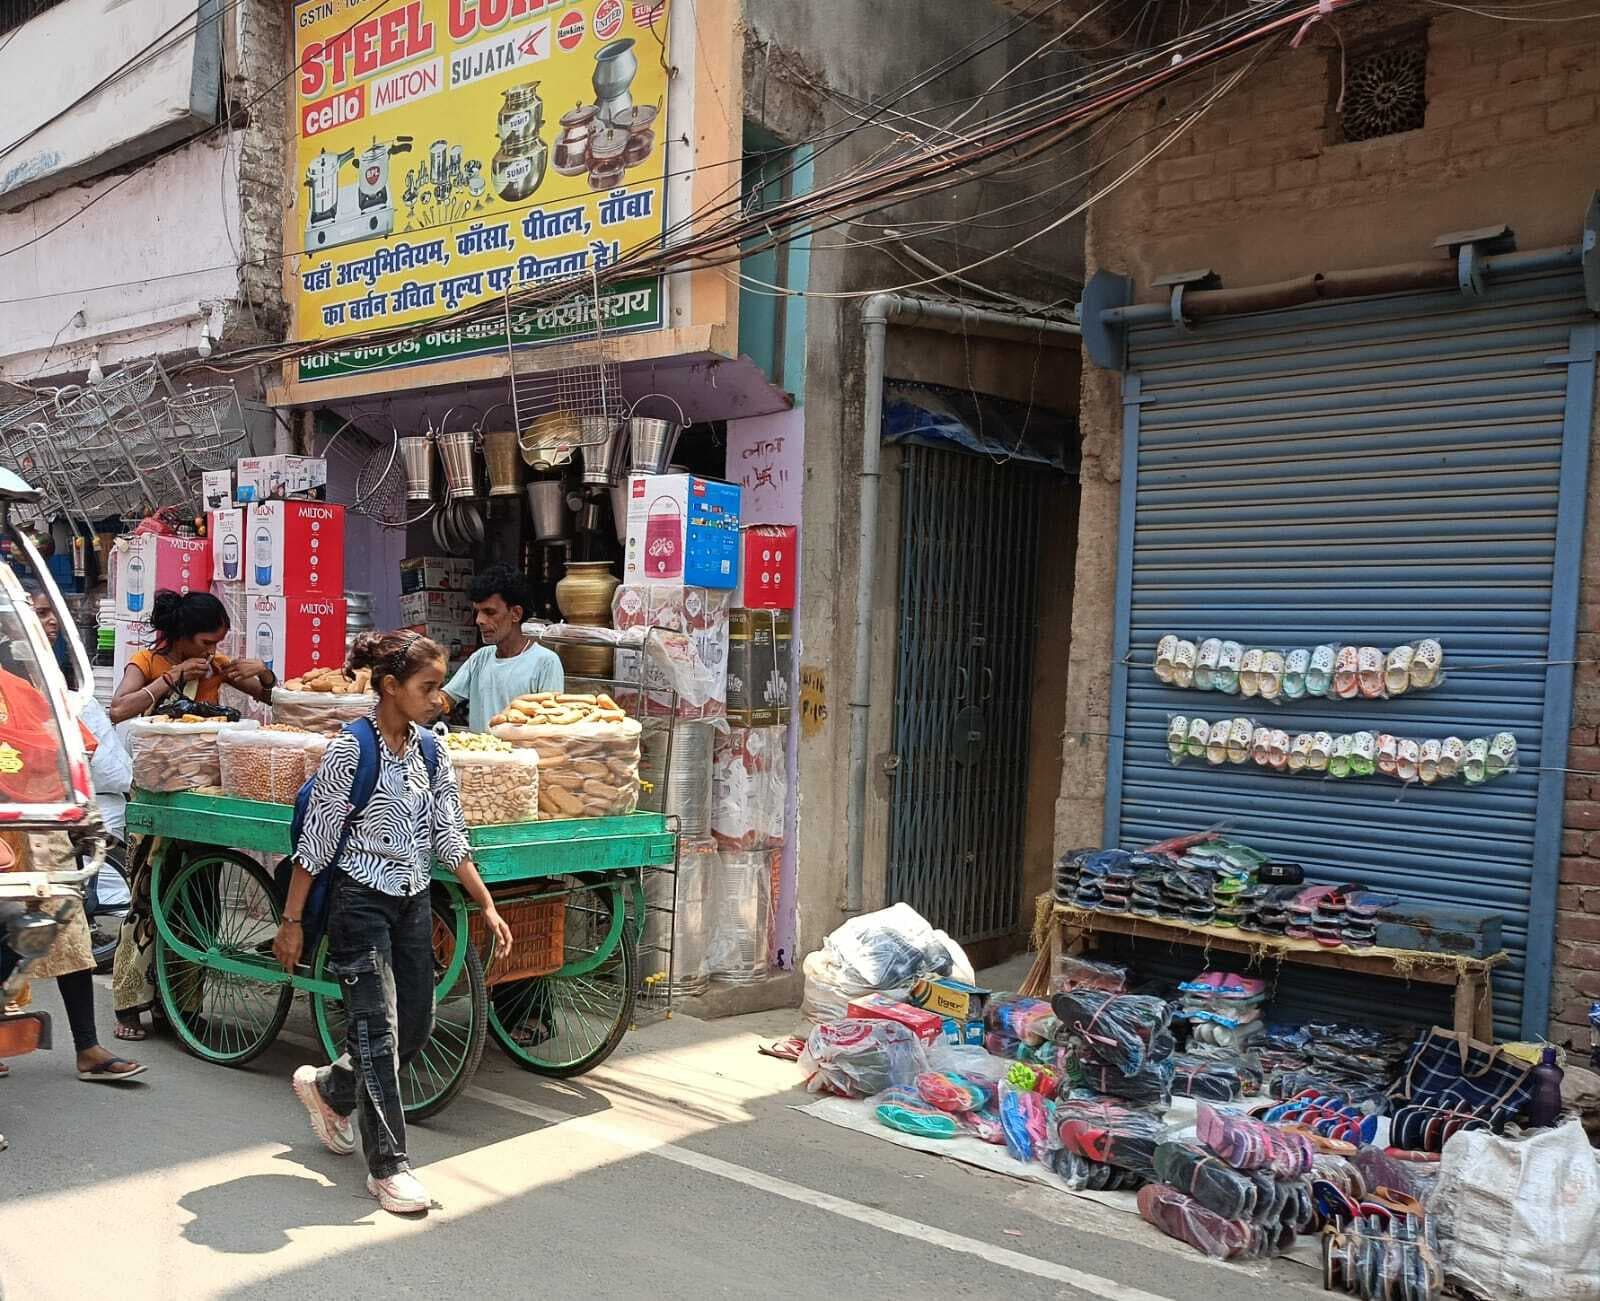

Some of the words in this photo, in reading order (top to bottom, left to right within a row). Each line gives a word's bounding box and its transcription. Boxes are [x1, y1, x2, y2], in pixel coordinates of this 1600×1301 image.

[300, 1, 333, 28] GSTIN
[301, 1, 434, 98] STEEL
[452, 42, 516, 85] SUJATA
[375, 63, 437, 109] MILTON
[305, 93, 360, 134] cello
[506, 164, 529, 178] SUMIT
[522, 206, 591, 241] पीतल,
[322, 303, 346, 326] का
[390, 281, 437, 313] उचित
[439, 272, 483, 309] मूल्य
[486, 265, 514, 292] पर
[298, 507, 334, 520] MILTON
[299, 602, 335, 615] MILTON
